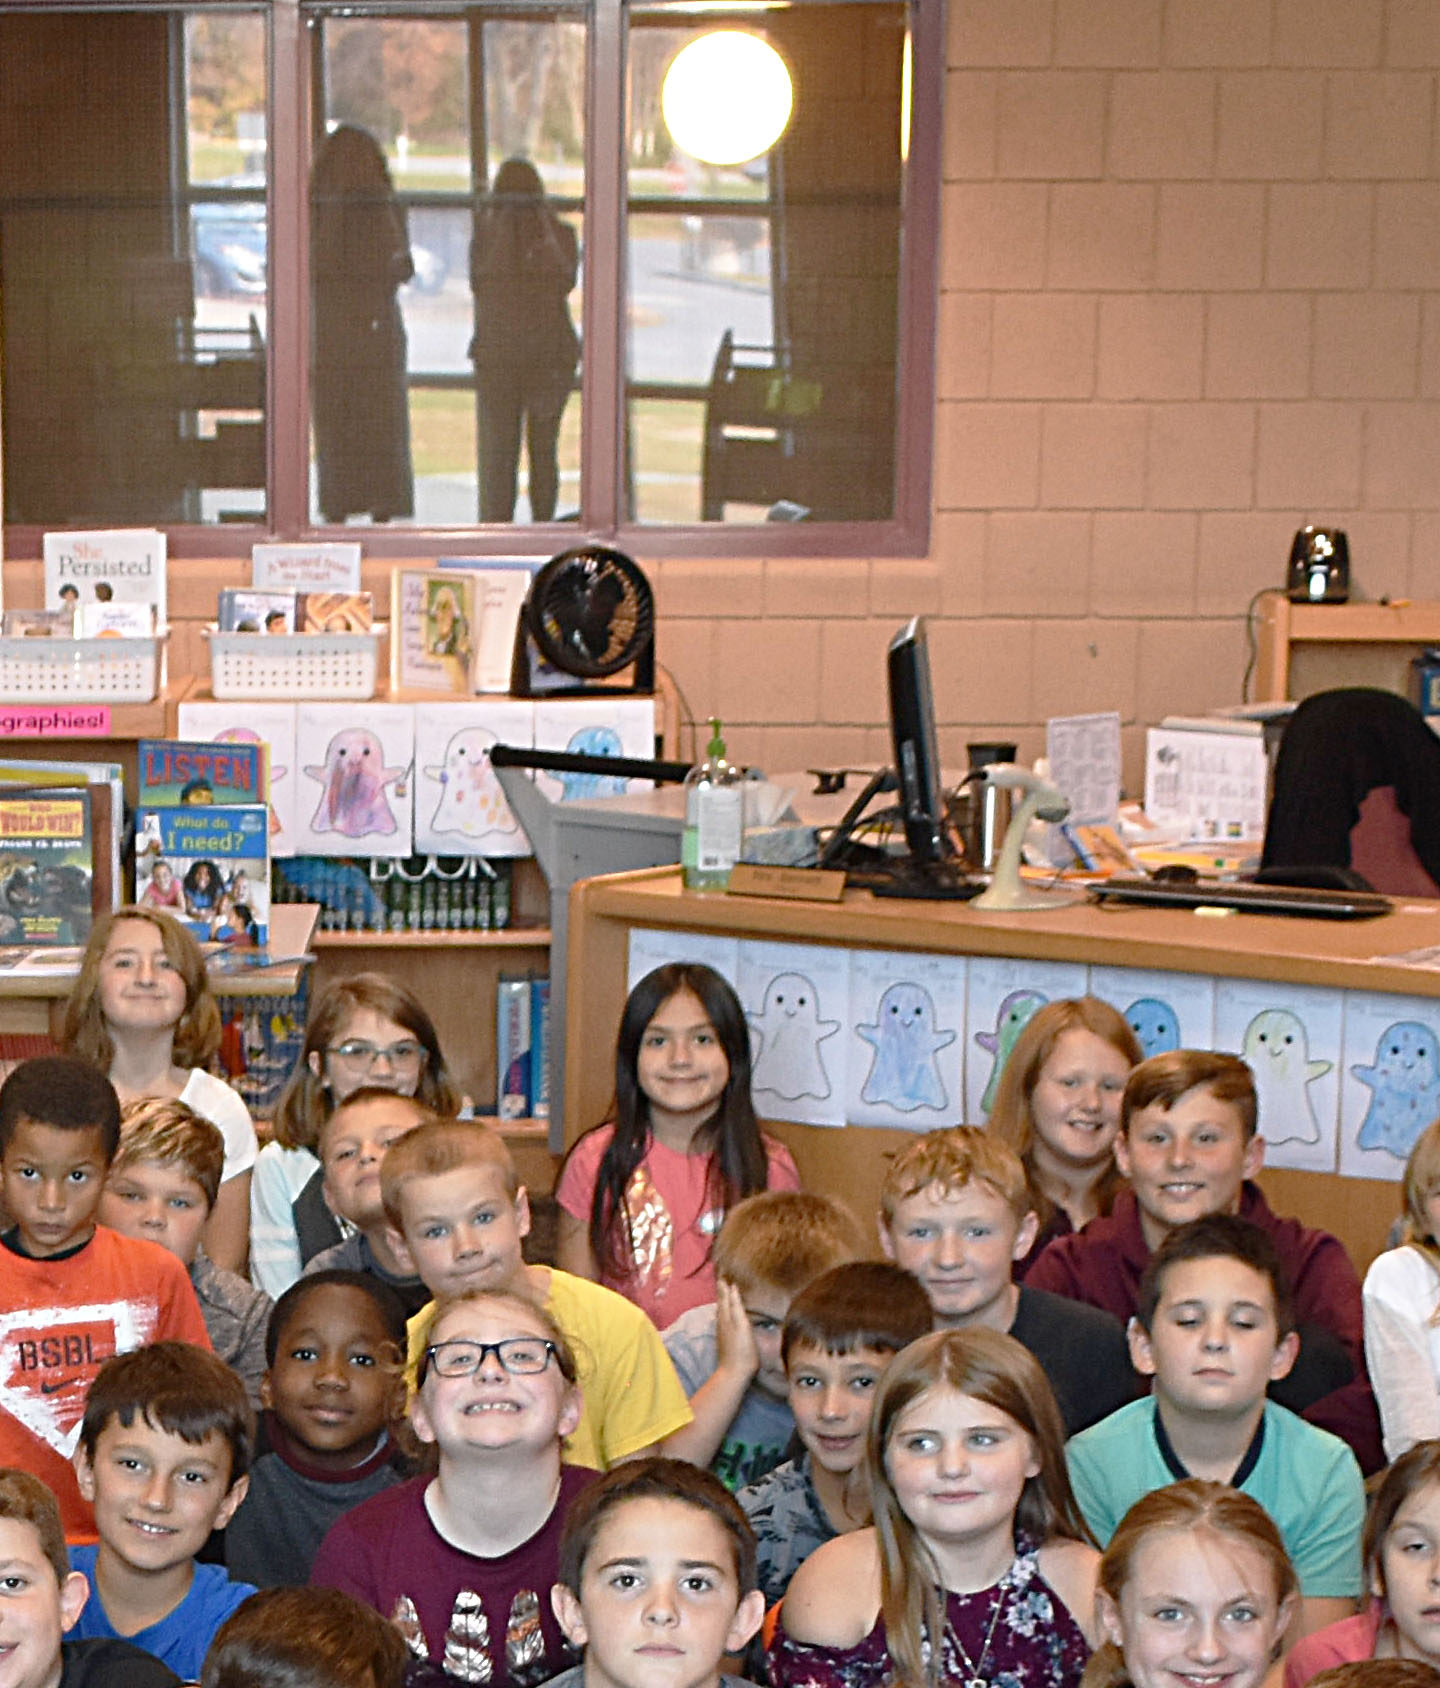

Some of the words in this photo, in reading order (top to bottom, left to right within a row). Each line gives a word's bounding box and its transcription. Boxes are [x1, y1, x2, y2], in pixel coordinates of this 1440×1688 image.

[58, 554, 153, 577] Persisted
[145, 752, 252, 792] LISTEN
[0, 813, 46, 834] WOULD
[174, 816, 208, 829] What
[212, 817, 229, 829] do
[168, 832, 176, 850] I
[182, 831, 246, 852] need?
[18, 1333, 107, 1371] BSBL
